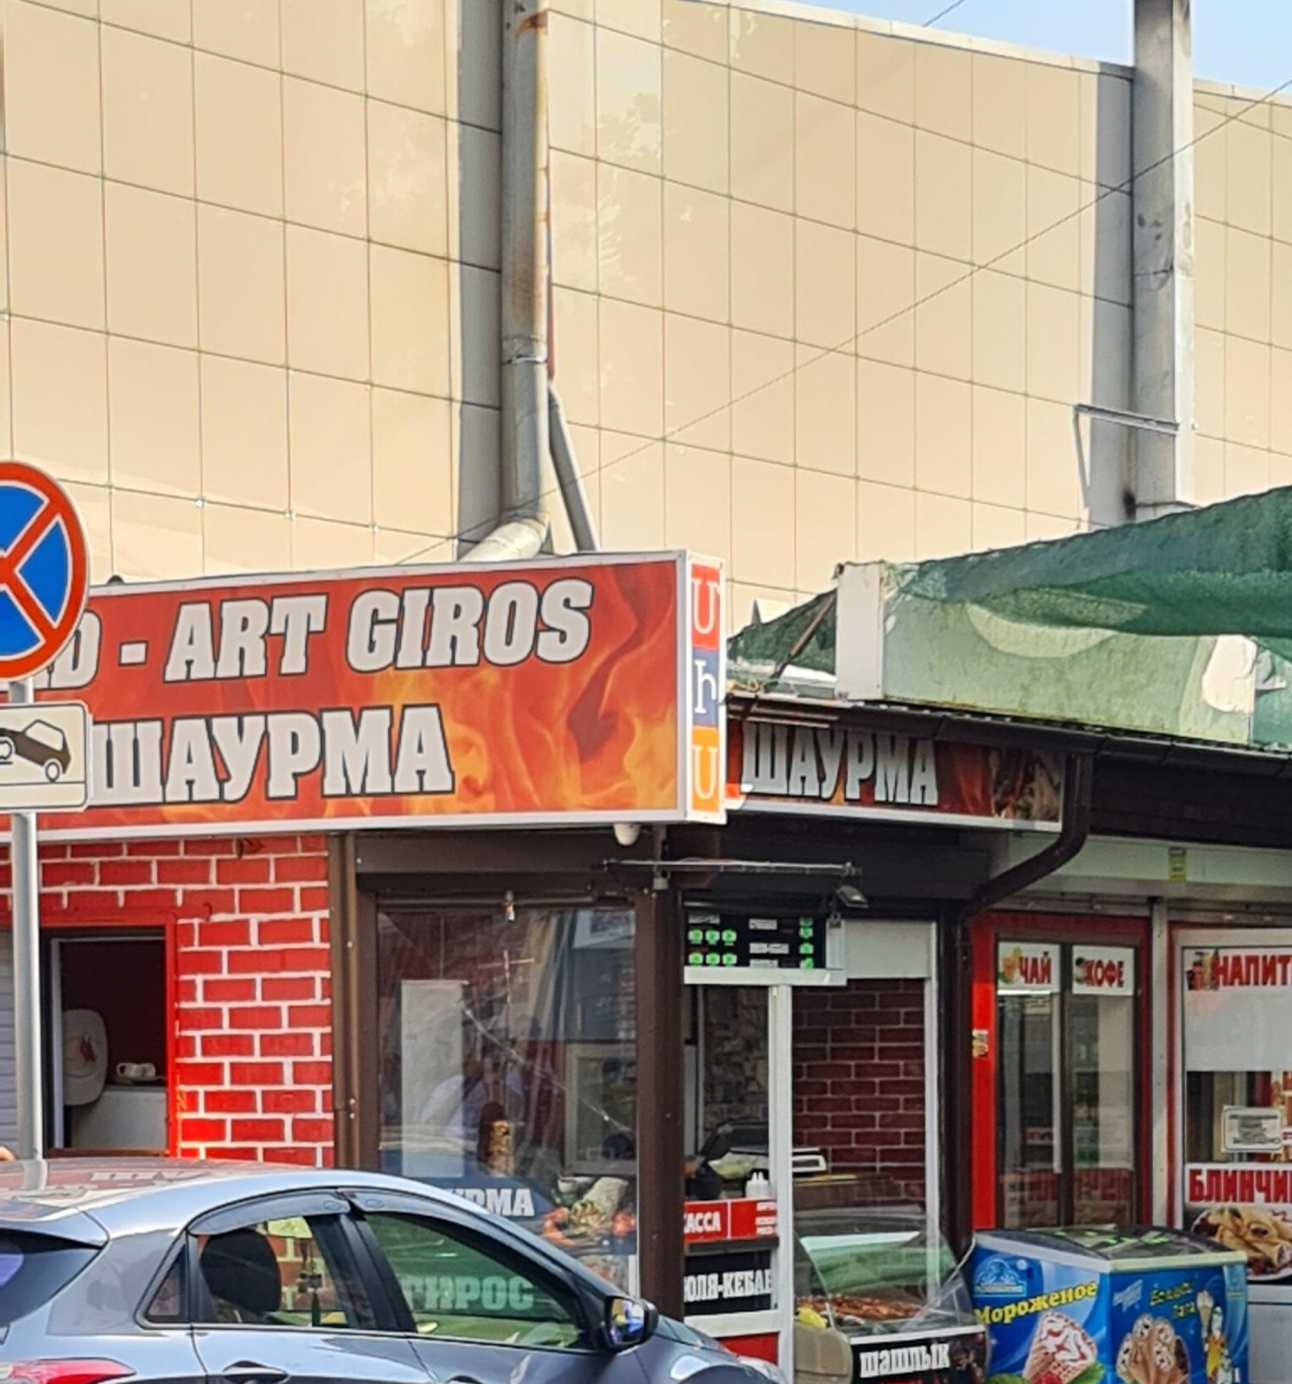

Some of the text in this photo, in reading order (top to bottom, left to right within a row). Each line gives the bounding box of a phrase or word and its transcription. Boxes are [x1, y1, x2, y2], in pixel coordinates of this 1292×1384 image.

[162, 593, 328, 683] ART
[346, 577, 594, 674] GIROS
[92, 703, 455, 807] ШАУРМА
[741, 724, 940, 807] ШАУРМА
[1019, 951, 1053, 985] ЧАЙ
[1083, 959, 1125, 988] КОФЕ
[453, 1187, 536, 1217] РМА
[1189, 1168, 1292, 1203] БЛИНЧИ
[974, 1280, 1099, 1326] Мороженое
